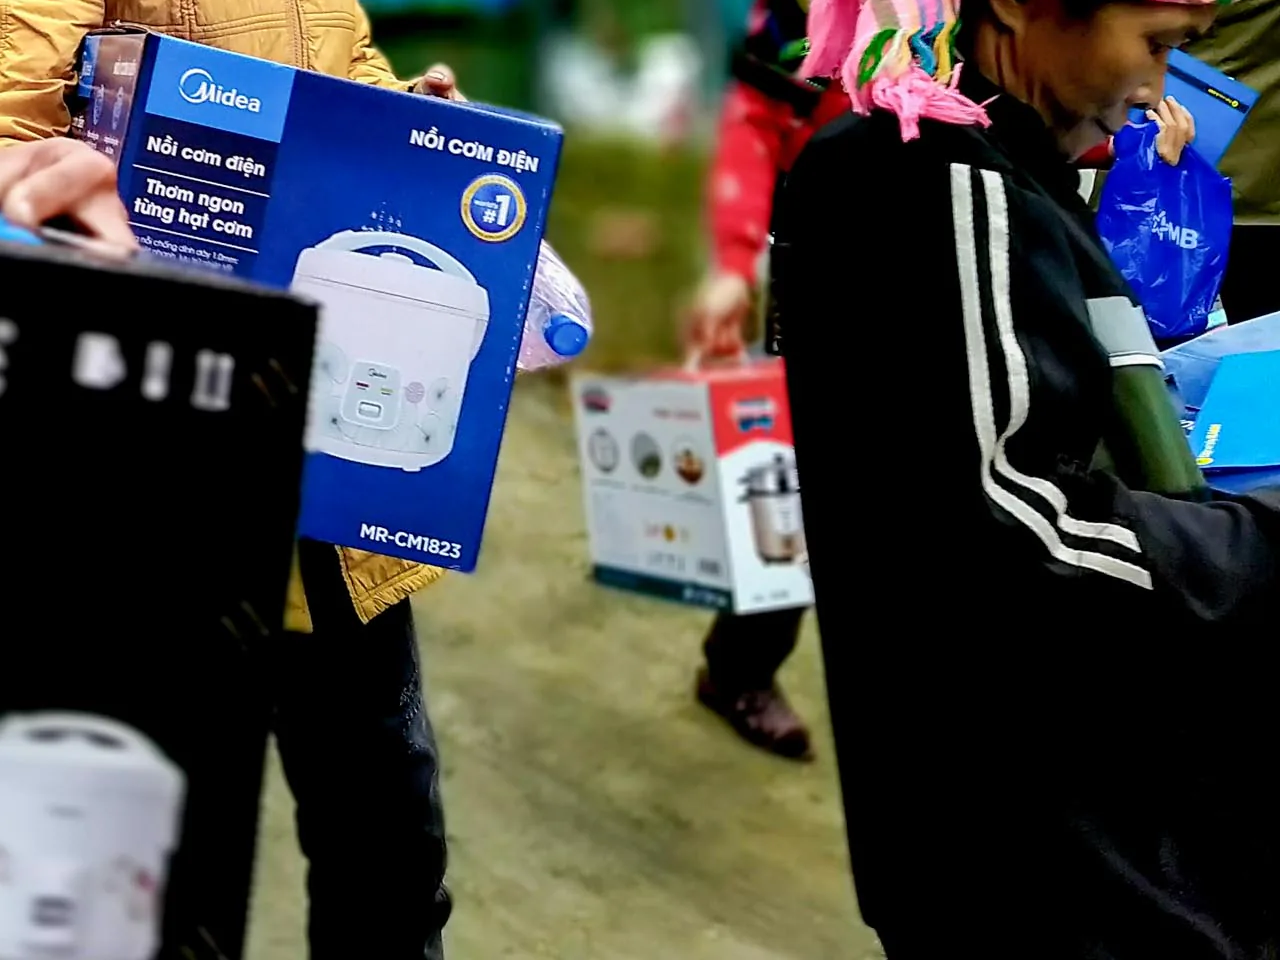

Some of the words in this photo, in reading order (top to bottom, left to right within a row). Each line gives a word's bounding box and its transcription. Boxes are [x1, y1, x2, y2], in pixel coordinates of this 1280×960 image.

[179, 68, 261, 113] Midea
[147, 135, 178, 157] Nồi
[181, 147, 222, 167] cơm
[225, 155, 266, 178] điện
[410, 126, 445, 151] NỒI
[448, 138, 494, 162] CƠM
[496, 150, 539, 173] ĐIỆN
[147, 178, 194, 203] Thơm
[198, 193, 244, 214] ngon
[134, 197, 175, 224] từng
[178, 208, 210, 230] hạt
[212, 219, 253, 238] cơm
[1169, 221, 1199, 249] MB
[360, 523, 462, 559] MR-CM1823
